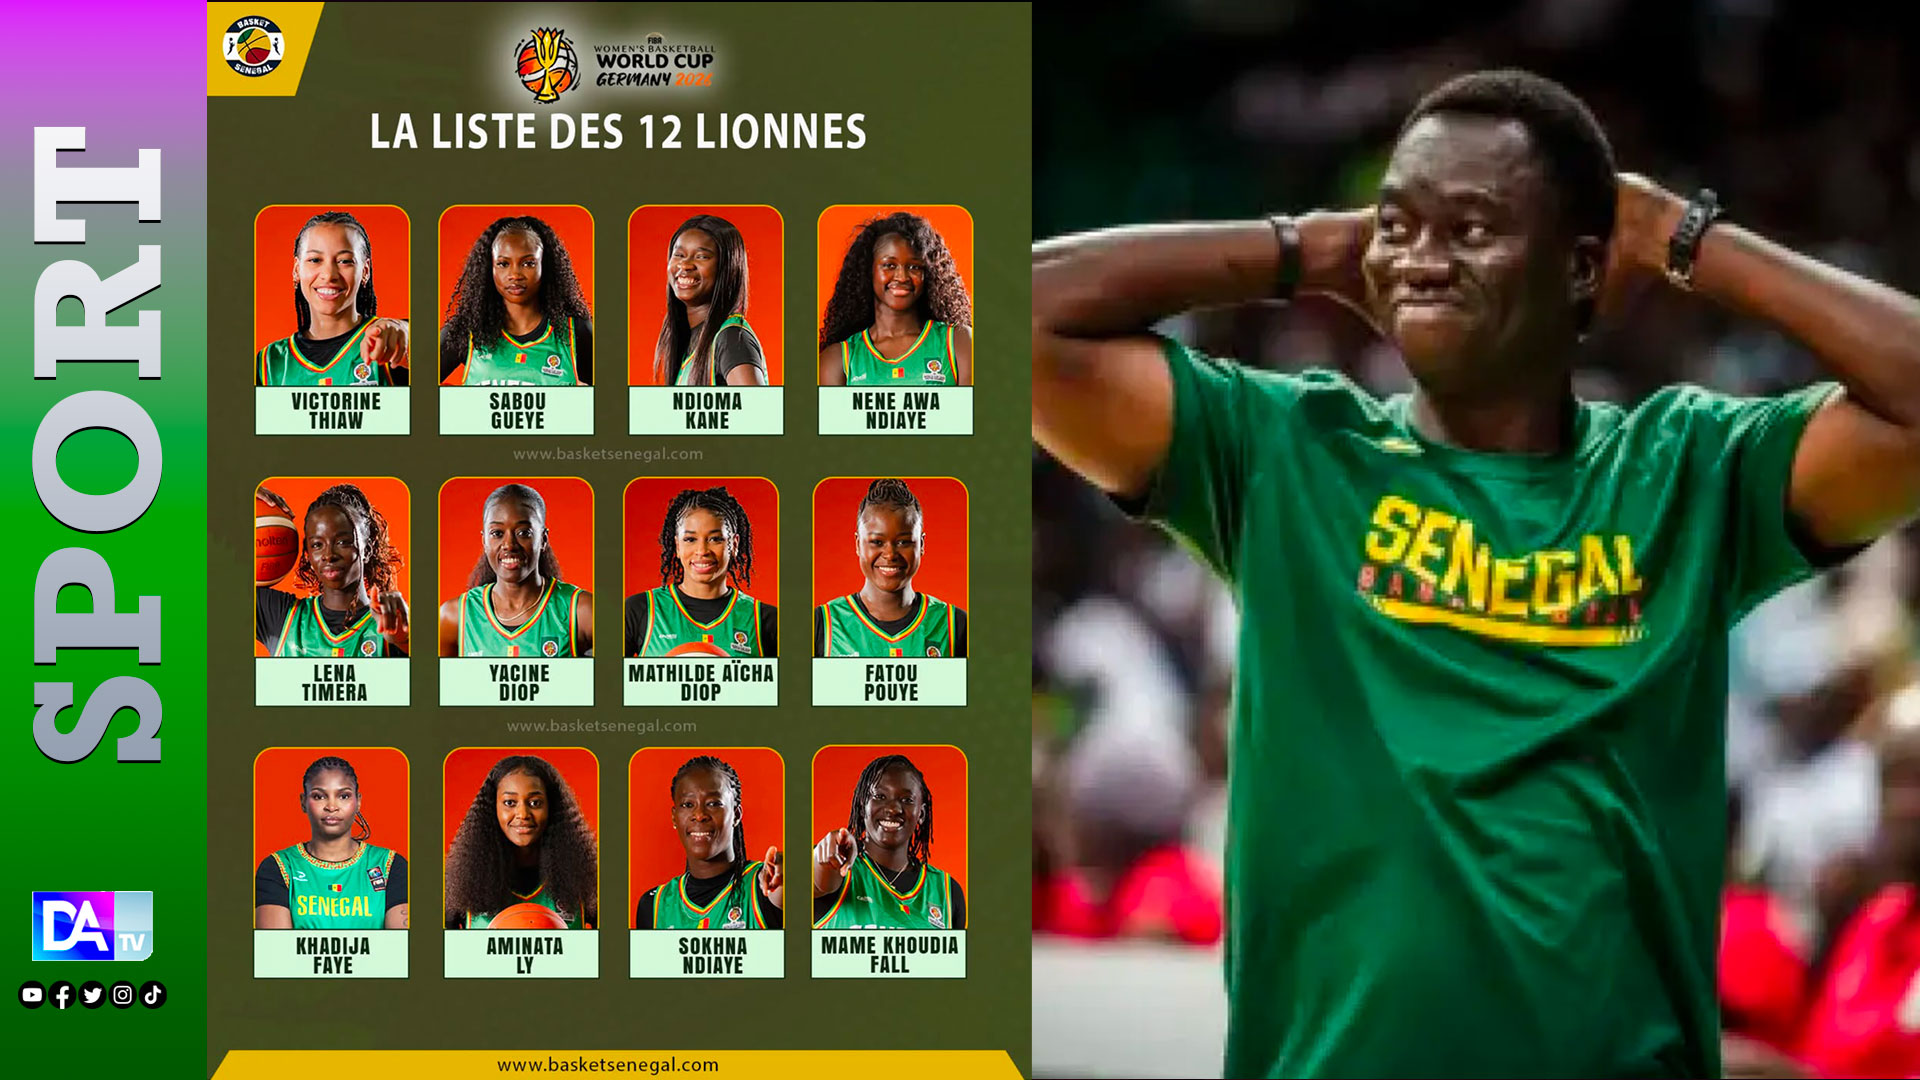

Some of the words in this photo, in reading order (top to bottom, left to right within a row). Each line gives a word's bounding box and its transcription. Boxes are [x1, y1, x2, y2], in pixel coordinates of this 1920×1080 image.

[237, 18, 270, 29] BASKET
[594, 45, 645, 53] WOMEN'S
[648, 45, 716, 53] BASKETBALL
[234, 63, 273, 75] SENEGAL
[596, 54, 668, 68] WORLD
[674, 54, 713, 68] CUP
[596, 72, 671, 87] GERMANY
[675, 72, 713, 87] 2026
[371, 113, 418, 149] LA
[433, 113, 536, 149] LISTE
[550, 113, 623, 149] DES
[639, 114, 682, 149] 12
[697, 113, 866, 149] LIONNES
[291, 392, 381, 411] VICTORINE
[489, 392, 546, 411] SABOU
[673, 392, 743, 411] NDIOMA
[852, 392, 896, 411] NENE
[903, 392, 940, 411] AWA
[308, 411, 364, 430] THIAW
[491, 411, 545, 430] GUEYE
[685, 411, 730, 430] KANE
[866, 411, 927, 430] NDIAYE
[1365, 496, 1642, 616] SENEGAL
[314, 664, 356, 683] LENA
[489, 664, 550, 683] YACINE
[628, 664, 715, 683] MATHILDE
[722, 659, 774, 683] AÏCHA
[865, 664, 917, 683] FATOU
[301, 683, 368, 702] TIMERA
[499, 683, 540, 702] DIOP
[681, 683, 721, 702] DIOP
[864, 683, 919, 702] POUYE
[297, 895, 373, 917] SENEGAL
[296, 936, 371, 955] KHADIJA
[486, 936, 564, 955] AMINATA
[678, 936, 748, 955] SOKHNA
[821, 936, 876, 955] MAME
[883, 936, 959, 955] KHOUDIA
[313, 956, 353, 975] FAYE
[516, 956, 534, 975] LY
[683, 956, 743, 975] NDIAYE
[870, 955, 910, 974] FALL
[497, 1055, 719, 1076] www.basketsenegal.com
